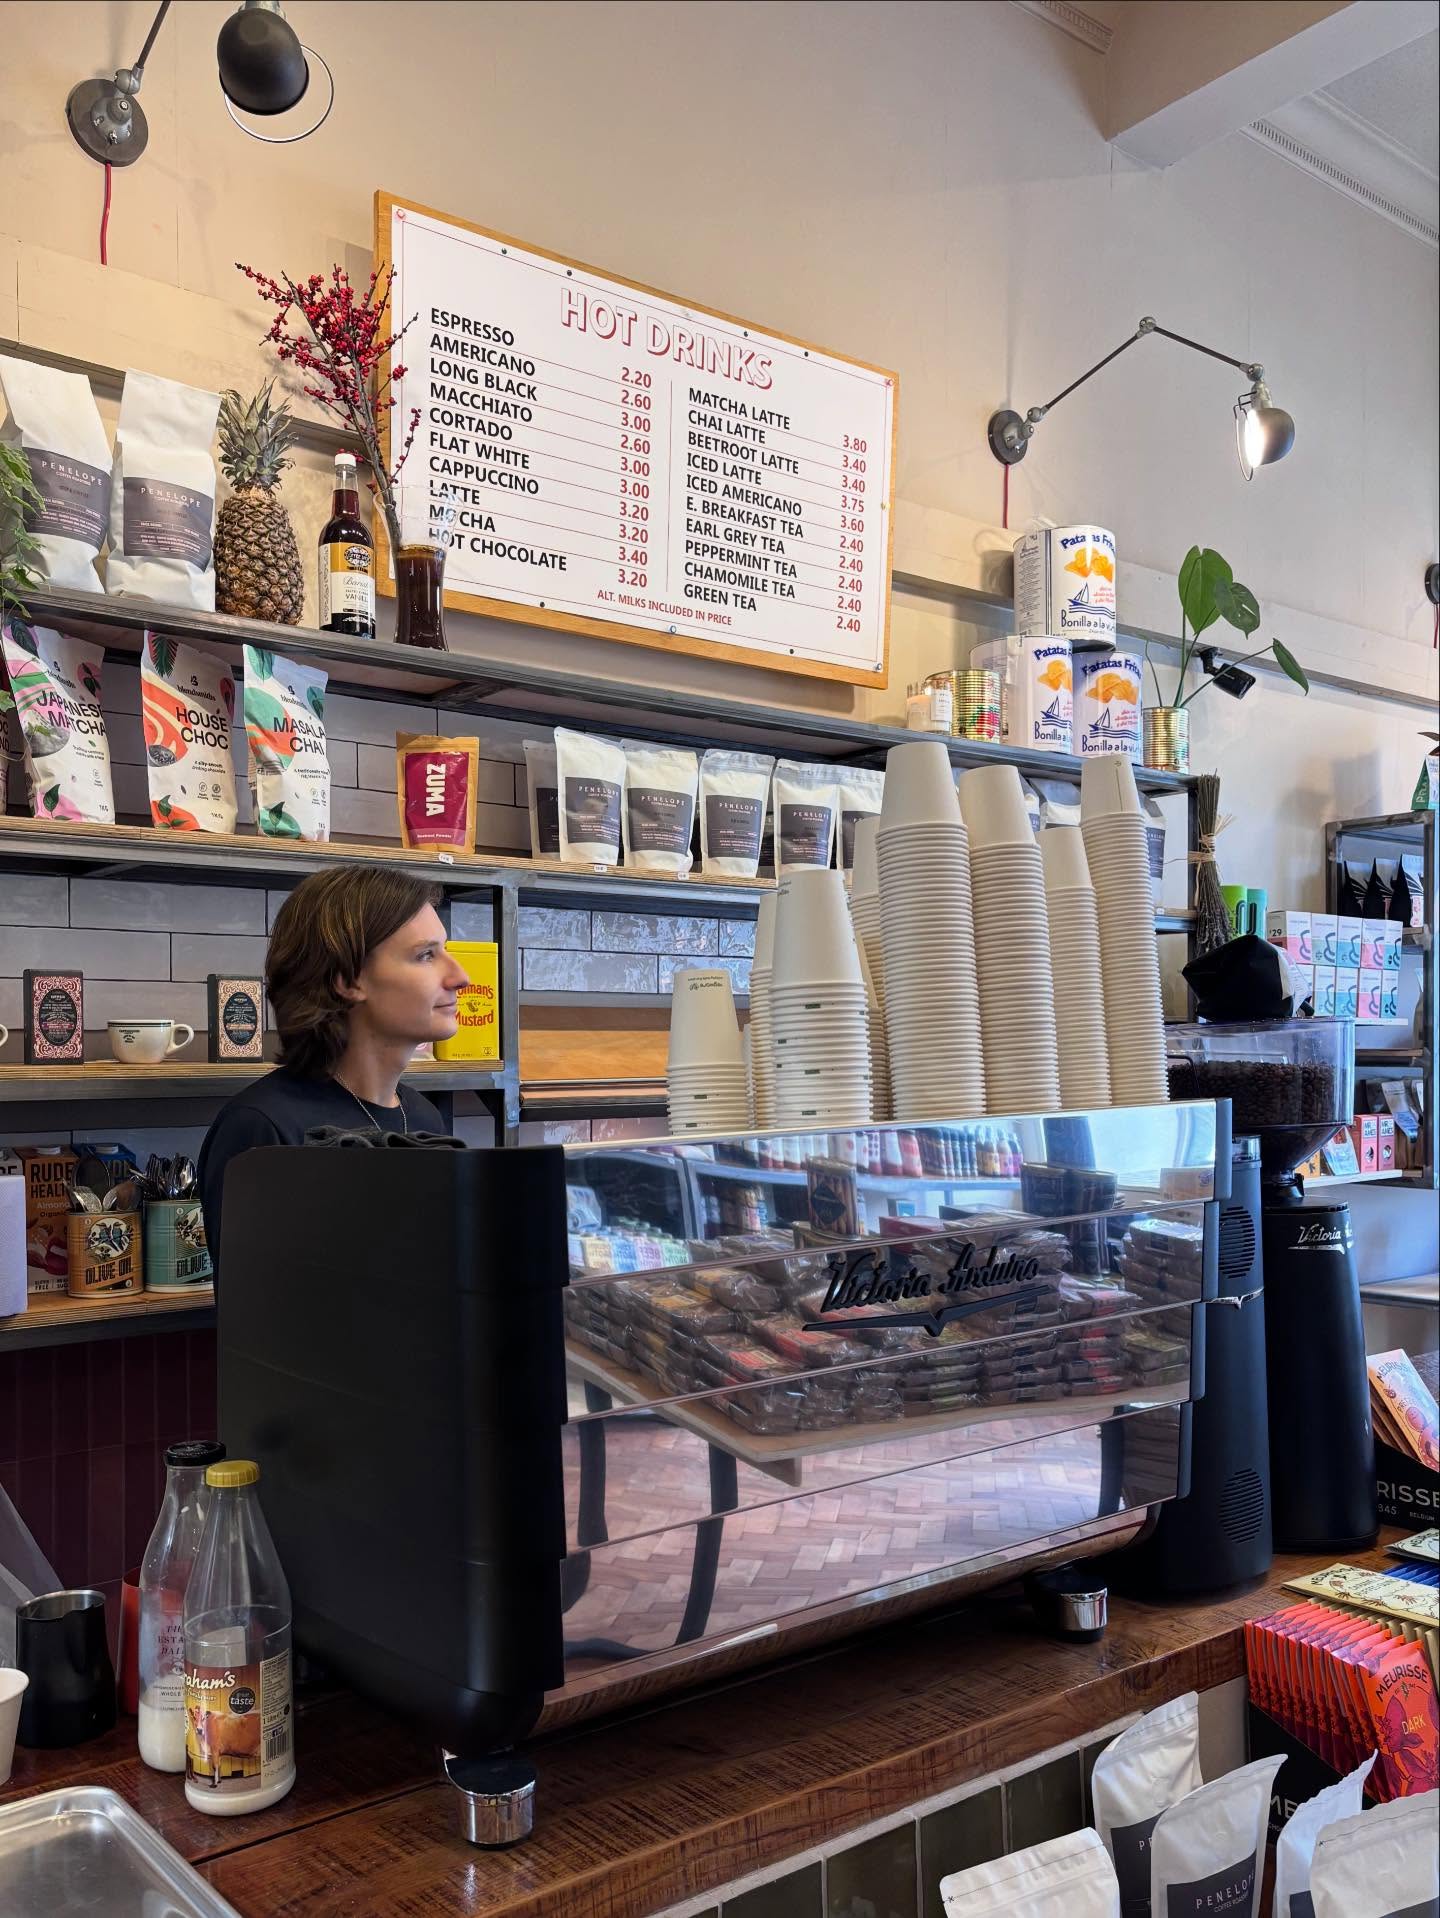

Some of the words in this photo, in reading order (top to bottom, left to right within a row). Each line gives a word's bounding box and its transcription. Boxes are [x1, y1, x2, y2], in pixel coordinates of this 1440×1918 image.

[430, 308, 514, 346] ESPRESSO
[561, 288, 637, 346] HOT
[646, 316, 773, 390] DRINKS
[430, 333, 536, 376] AMERICANO
[430, 357, 479, 385] LONG
[484, 372, 537, 401] BLACK
[621, 367, 651, 388] 2.20
[430, 382, 533, 423] MACCHIATO
[621, 389, 651, 410] 2.60
[689, 387, 748, 418] MATCHA
[751, 407, 790, 430] LATTE
[429, 407, 513, 440] CORTADO
[620, 411, 651, 433] 3.00
[688, 410, 723, 432] CHAI
[726, 421, 766, 444] LATTE
[430, 431, 470, 454] FLAT
[474, 442, 530, 470] WHITE
[620, 434, 650, 454] 2.60
[687, 431, 758, 463] BEETROOT
[761, 453, 799, 475] LATTE
[843, 434, 867, 453] 3.80
[42, 461, 103, 486] PENELOPE
[429, 455, 539, 494] CAPPUCCINO
[620, 456, 650, 477] 3.00
[687, 453, 718, 474] ICED
[722, 463, 762, 485] LATTE
[842, 455, 866, 473] 3.40
[429, 479, 480, 505] LATTE
[619, 479, 649, 499] 3.00
[841, 475, 865, 493] 3.40
[141, 487, 201, 508] PENELOPE
[686, 474, 718, 495] ICED
[721, 484, 802, 516] AMERICANO
[841, 495, 865, 513] 3.75
[429, 504, 496, 533] MOCHA
[619, 501, 649, 521] 3.20
[686, 496, 698, 511] E.
[701, 502, 776, 530] BREAKFAST
[779, 519, 804, 538] TEA
[619, 524, 649, 543] 3.20
[840, 515, 864, 533] 3.60
[686, 518, 720, 538] EARL
[724, 528, 758, 550] GREY
[761, 539, 785, 554] TEA
[839, 535, 864, 553] 2.40
[1060, 534, 1101, 550] Pataas
[428, 527, 465, 550] HOT
[469, 537, 567, 571] CHOCOLATE
[618, 546, 648, 566] 3.40
[685, 540, 770, 572] PEPPERMINT
[773, 561, 797, 579] TEA
[838, 555, 863, 573] 2.40
[618, 568, 647, 588] 3.20
[684, 561, 768, 592] CHAMOMILE
[772, 581, 796, 599] TEA
[838, 575, 862, 593] 2.40
[597, 589, 616, 602] ALT.
[618, 593, 646, 608] MILKS
[649, 600, 694, 620] INCLUDED
[696, 610, 705, 621] IN
[708, 612, 732, 626] PRICE
[683, 583, 729, 605] GREEN
[732, 594, 757, 612] TEA
[837, 595, 862, 613] 2.40
[836, 616, 861, 633] 2.40
[1061, 609, 1092, 628] Bonilla
[1033, 646, 1067, 661] Patatas
[1081, 660, 1123, 677] Patatas
[48, 710, 106, 737] MATCHA
[176, 706, 229, 733] HOUSE
[273, 717, 326, 739] MASALA
[180, 727, 229, 750] CHOC
[1034, 721, 1061, 741] Bonilla
[289, 736, 325, 755] CHAI
[1082, 735, 1113, 752] Bonilla
[426, 763, 446, 817] ZUMA
[578, 785, 619, 796] PENELOPE
[641, 795, 686, 807] PENELOPE
[719, 802, 758, 812] PENELOPE
[793, 811, 829, 819] PENELOPE
[457, 983, 494, 1000] olman's
[455, 1009, 494, 1027] Mustard
[31, 1162, 73, 1183] RUDE
[31, 1182, 69, 1199] HEALT
[1298, 1223, 1342, 1243] Victoria
[85, 1261, 116, 1285] OLIVE
[119, 1256, 134, 1276] OIL
[176, 1252, 208, 1278] OLIVE
[820, 1252, 932, 1314] Victoria
[937, 1242, 1041, 1295] Arduino
[1376, 1480, 1440, 1509] RISSE
[1409, 1511, 1436, 1522] BELGIUM
[158, 1635, 184, 1644] ESTA
[1376, 1664, 1428, 1702] MEURISSE
[230, 1697, 254, 1705] taste
[1402, 1715, 1426, 1735] DARK
[1214, 1900, 1233, 1913] COFFEE
